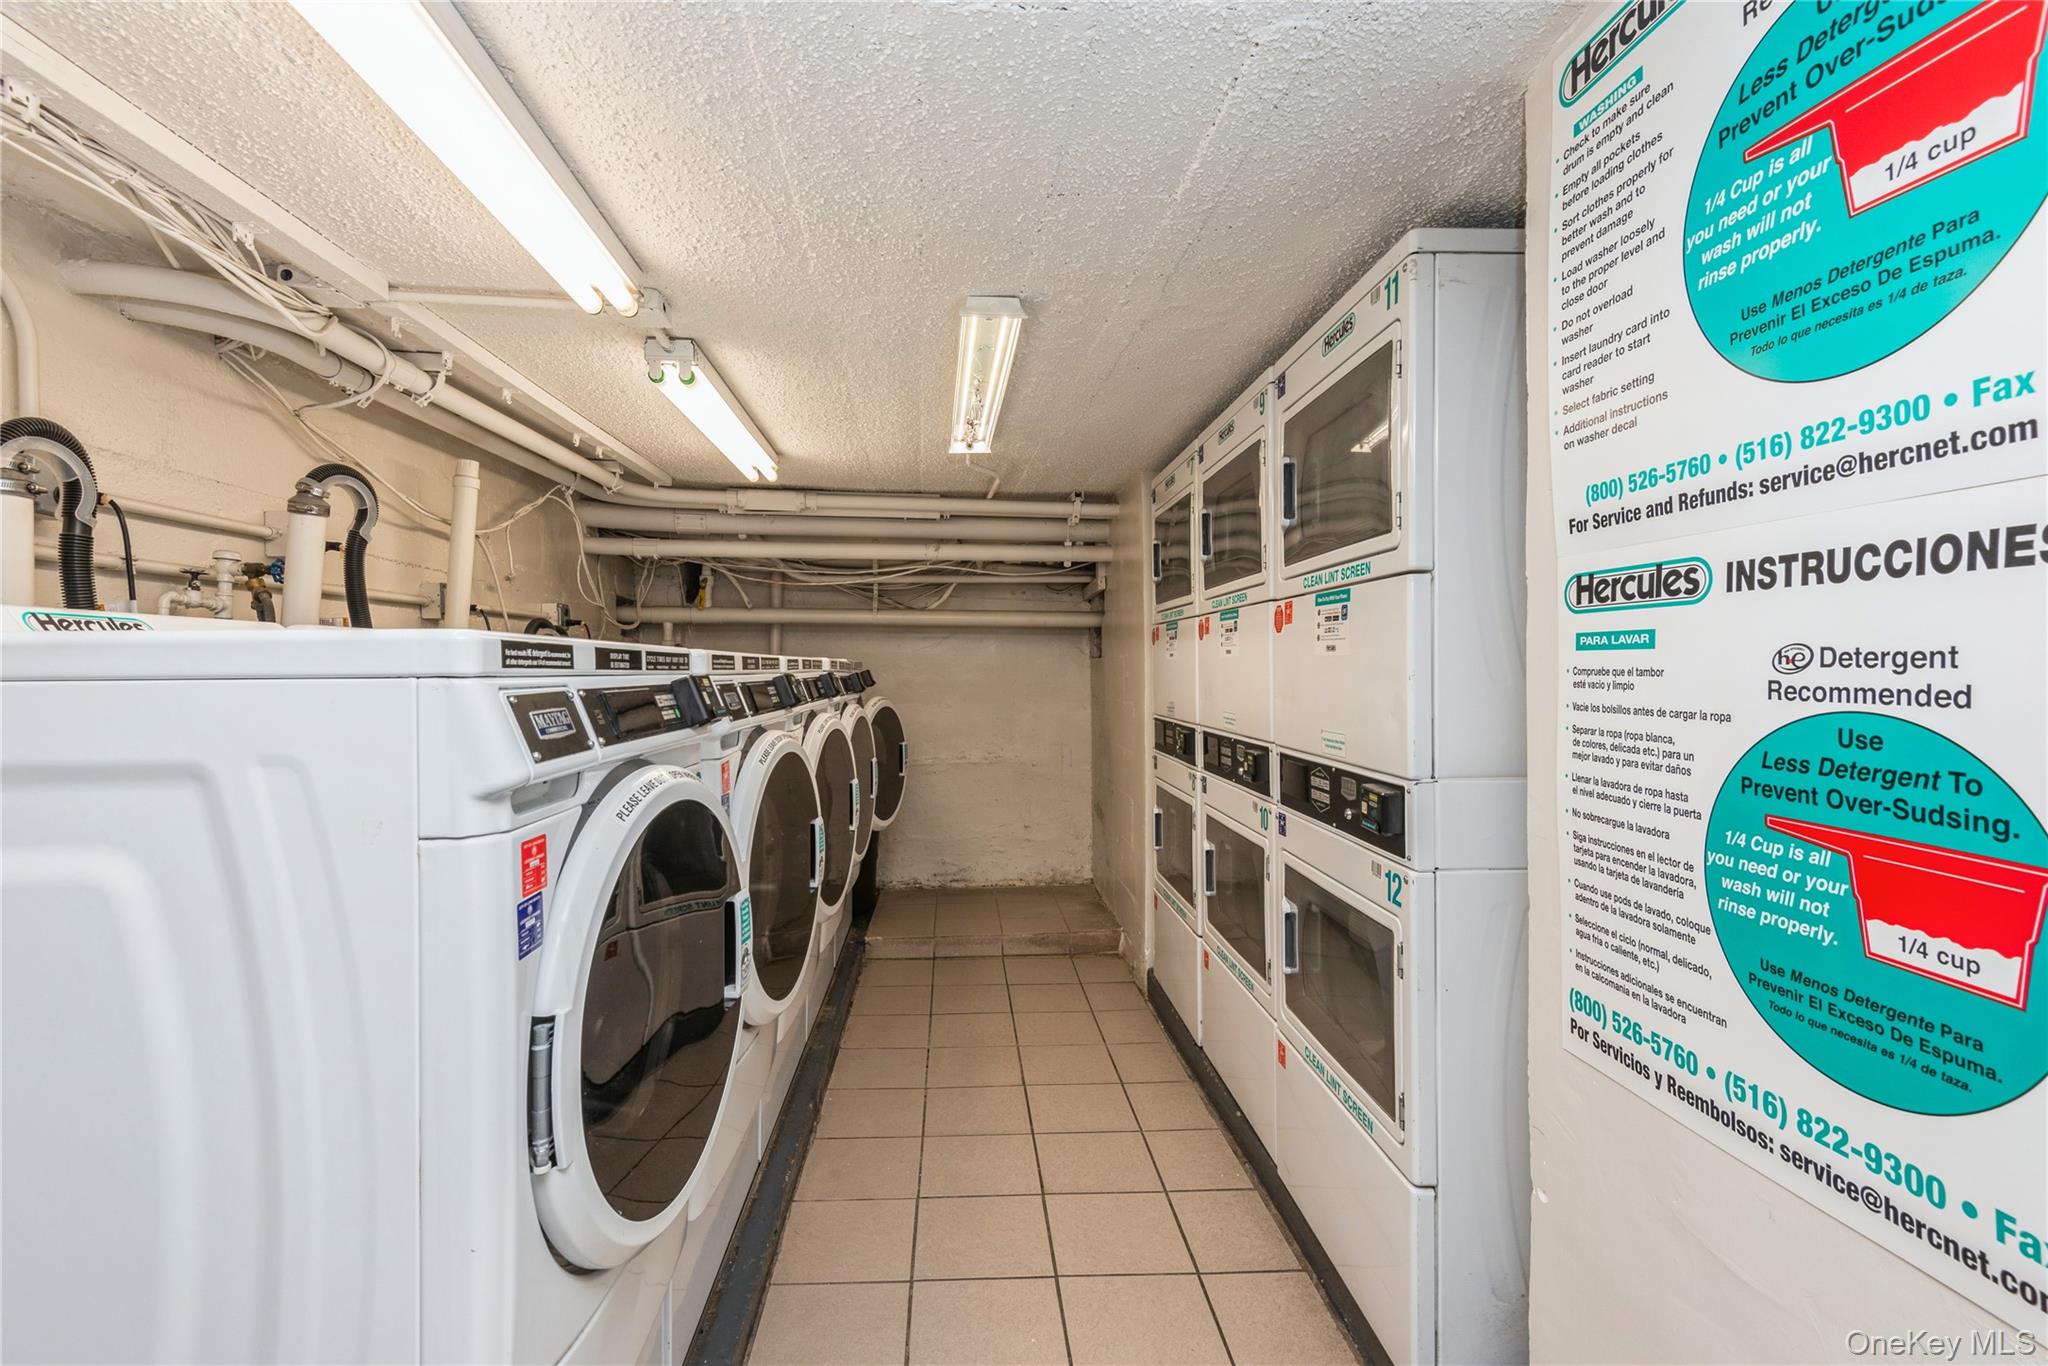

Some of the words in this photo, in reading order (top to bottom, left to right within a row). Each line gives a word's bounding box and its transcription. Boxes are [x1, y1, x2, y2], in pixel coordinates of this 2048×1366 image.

[1571, 0, 1673, 96] Hercu
[1719, 81, 1797, 149] Prevent
[1806, 0, 1945, 89] Over-Sud
[1739, 58, 1789, 106] Less
[1797, 0, 1889, 64] Deterg
[1579, 75, 1637, 130] WASHING
[1705, 190, 1726, 215] 1/4
[1730, 170, 1764, 199] Cup
[1769, 157, 1785, 177] is
[1789, 134, 1813, 165] all
[1885, 152, 1918, 181] 1/4
[1928, 127, 1976, 161] cup
[1687, 224, 1714, 254] you
[1719, 194, 1759, 232] need
[1763, 184, 1782, 206] or
[1786, 156, 1836, 198] your
[1702, 232, 1742, 265] wash
[1747, 211, 1776, 240] will
[1781, 192, 1812, 223] not
[1562, 261, 1583, 281] Load
[1585, 241, 1618, 267] washer
[1621, 219, 1655, 246] loosely
[1699, 262, 1737, 290] rinse
[1741, 220, 1821, 274] properly.
[1741, 303, 1767, 321] Use
[1772, 278, 1822, 308] Menos
[1828, 233, 1926, 284] Detergente
[1933, 211, 1979, 240] Para
[1384, 270, 1399, 310] 11
[1730, 314, 1786, 346] Prevenir
[1792, 304, 1805, 321] El
[1811, 280, 1871, 313] Exceso
[1878, 267, 1902, 286] De
[1910, 230, 2000, 273] Espuma.
[1751, 341, 1775, 356] Todo
[1778, 336, 1788, 346] lo
[1791, 327, 1812, 343] que
[1815, 307, 1864, 332] necesita
[1868, 299, 1883, 312] es
[1889, 288, 1907, 304] 1/4
[1911, 282, 1929, 295] de
[1934, 268, 1967, 287] taza.
[1563, 411, 1607, 436] Additional
[1610, 391, 1668, 419] instructions
[1586, 478, 1623, 506] (800)
[1629, 454, 1711, 492] 526-5760
[1736, 432, 1792, 470] (516)
[1801, 395, 1930, 449] 822-9300
[1973, 372, 2034, 407] Fax
[1569, 518, 1589, 535] For
[1593, 507, 1642, 530] Service
[1646, 496, 1673, 519] and
[1679, 481, 1753, 512] Refunds:
[1760, 419, 2038, 495] service@hercnet.com
[1304, 575, 1323, 589] CLEAN
[1325, 570, 1339, 584] LINT
[1341, 562, 1371, 581] SCREEN
[1575, 563, 1700, 606] Hercules
[1727, 524, 2048, 593] INSTRUCCIONE
[1580, 636, 1609, 645] PARA
[1612, 634, 1649, 645] LAVAR
[1820, 646, 1959, 675] Detergent
[1573, 666, 1610, 678] Compruebe
[1612, 669, 1626, 678] que
[1627, 667, 1634, 677] el
[1636, 667, 1665, 678] tambor
[1768, 680, 1972, 709] Recommended
[534, 711, 570, 728] MAYTAG
[1838, 728, 1884, 752] Use
[616, 794, 642, 822] PLEASE
[637, 779, 660, 797] LEAVE
[1762, 751, 1810, 774] Less
[1818, 757, 1941, 791] Detergent
[1948, 771, 1983, 796] To
[1260, 806, 1269, 831] 10
[1572, 808, 1581, 818] No
[1583, 812, 1625, 829] sobrecargue
[1627, 821, 1634, 831] la
[1636, 823, 1670, 840] lavadora
[1742, 776, 1818, 806] Prevent
[1826, 789, 2019, 843] Over-Sudsing.
[1707, 851, 1734, 868] you
[1739, 859, 1779, 879] need
[1782, 870, 1802, 884] or
[1805, 876, 1849, 896] your
[1726, 831, 1746, 848] 1/4
[1751, 836, 1784, 859] Cup
[1789, 844, 1804, 861] is
[1809, 850, 1832, 867] all
[1385, 870, 1402, 908] 12
[1722, 877, 1761, 898] wash
[1767, 889, 1795, 907] will
[1800, 899, 1830, 917] not
[1718, 897, 1756, 919] rinse
[1760, 911, 1838, 946] properly.
[1899, 936, 1929, 959] 1/4
[1937, 951, 1980, 977] cup
[1576, 949, 1619, 978] Instrucciones
[1621, 972, 1663, 998] adicionales
[1665, 993, 1675, 1004] se
[1677, 999, 1727, 1028] encuentran
[1761, 958, 1785, 978] Use
[1790, 969, 1839, 997] Menos
[1844, 988, 1935, 1033] Detergente
[1941, 1023, 1983, 1053] Para
[1749, 972, 1804, 1003] Prevenir
[1809, 995, 1822, 1011] El
[1828, 1002, 1885, 1036] Exceso
[1891, 1026, 1913, 1047] De
[1920, 1037, 2002, 1084] Espuma.
[1769, 1000, 1793, 1017] Todo
[1795, 1011, 1805, 1022] lo
[1808, 1018, 1828, 1031] que
[1831, 1028, 1878, 1053] necesita
[1881, 1048, 1895, 1060] es
[1901, 1055, 1917, 1069] 1/4
[1921, 1065, 1937, 1077] de
[1941, 1072, 1972, 1093] taza.
[1305, 1050, 1325, 1077] CLEAN
[1327, 1071, 1341, 1095] LINT
[1343, 1090, 1373, 1134] SCREEN
[1571, 1018, 1590, 1042] Por
[1593, 1031, 1650, 1080] Servicios
[1654, 1071, 1663, 1090] y
[1667, 1074, 1774, 1154] Reembolsos:
[1570, 989, 1607, 1029] (800)
[1613, 1012, 1698, 1076] 526-5760
[1725, 1072, 1787, 1130] (516)
[1797, 1109, 1946, 1209] 822-9300
[1996, 1210, 2048, 1268] Fa
